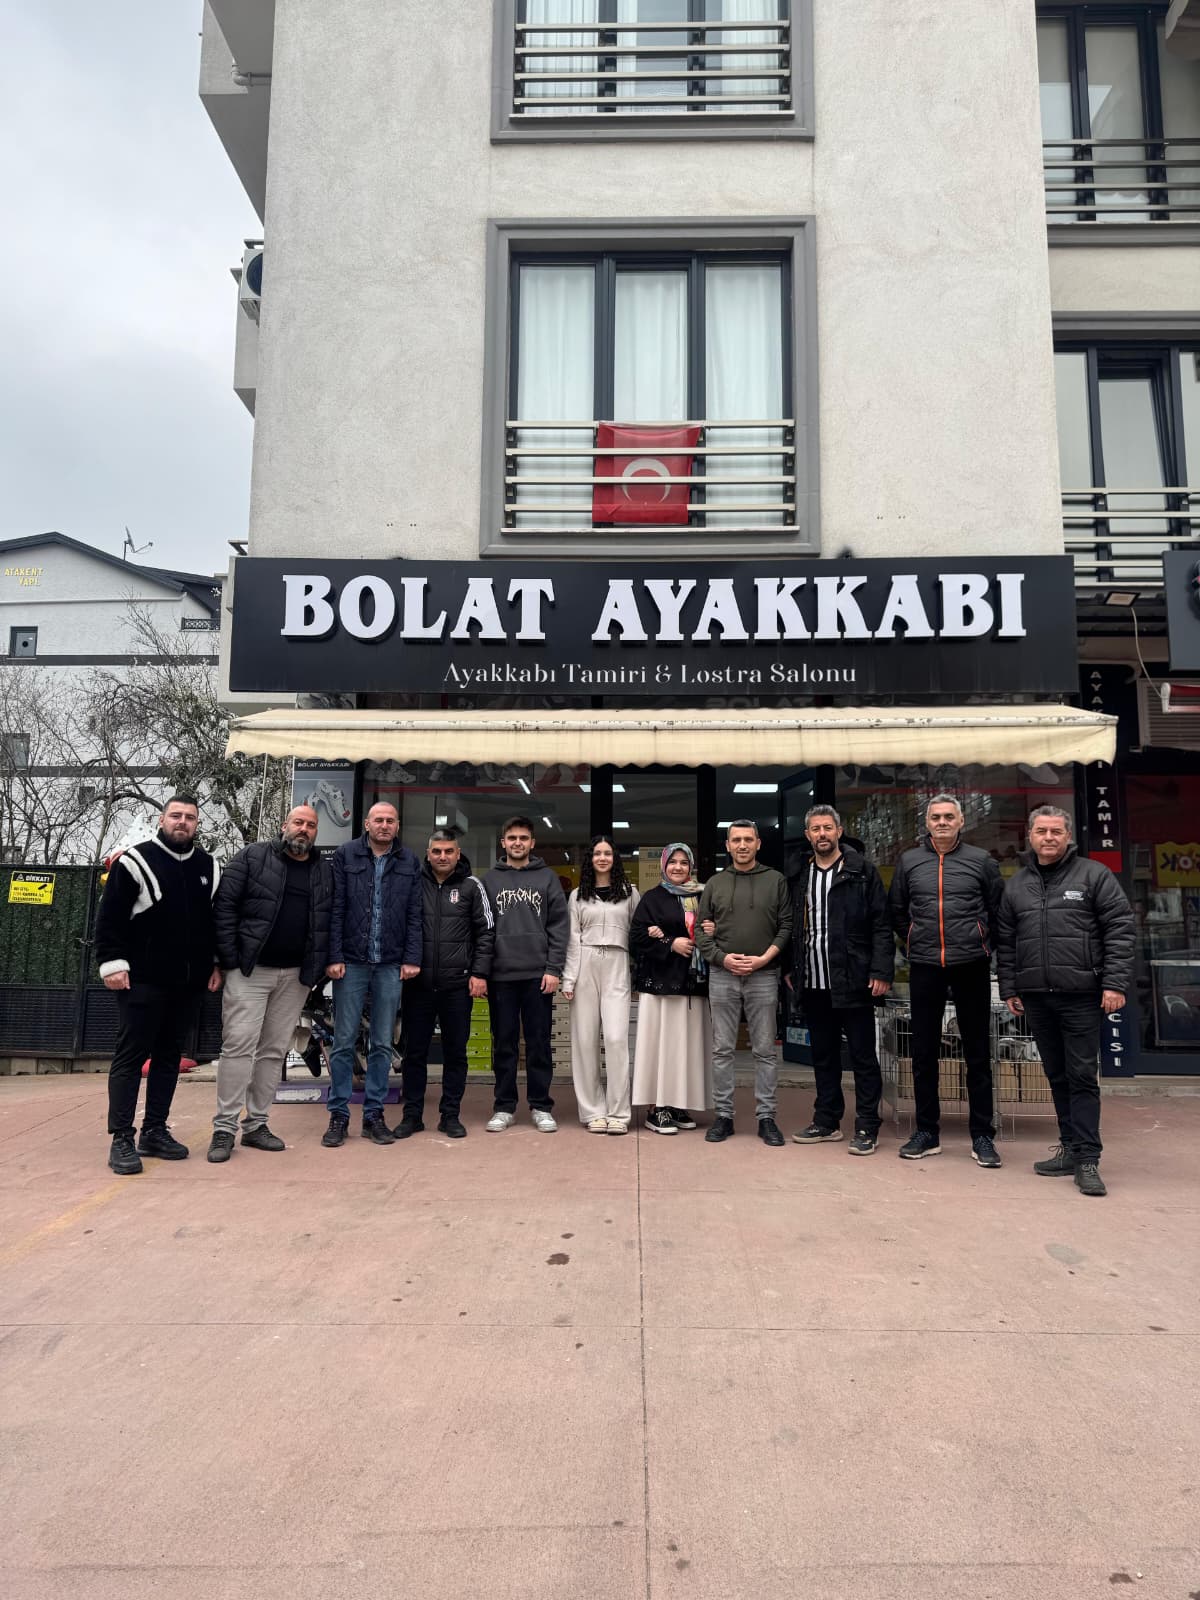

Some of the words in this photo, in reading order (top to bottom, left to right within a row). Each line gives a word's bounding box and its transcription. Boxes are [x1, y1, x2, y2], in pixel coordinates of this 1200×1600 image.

[5, 567, 44, 576] ATAKENT
[280, 574, 556, 640] BOLAT
[591, 573, 1027, 641] AYAKKABI
[444, 662, 556, 689] Ayakkabı
[562, 663, 646, 684] Tamiri
[655, 663, 673, 684] &
[681, 664, 762, 684] Lostra
[770, 662, 857, 684] Salonu
[495, 887, 543, 918] STRONG
